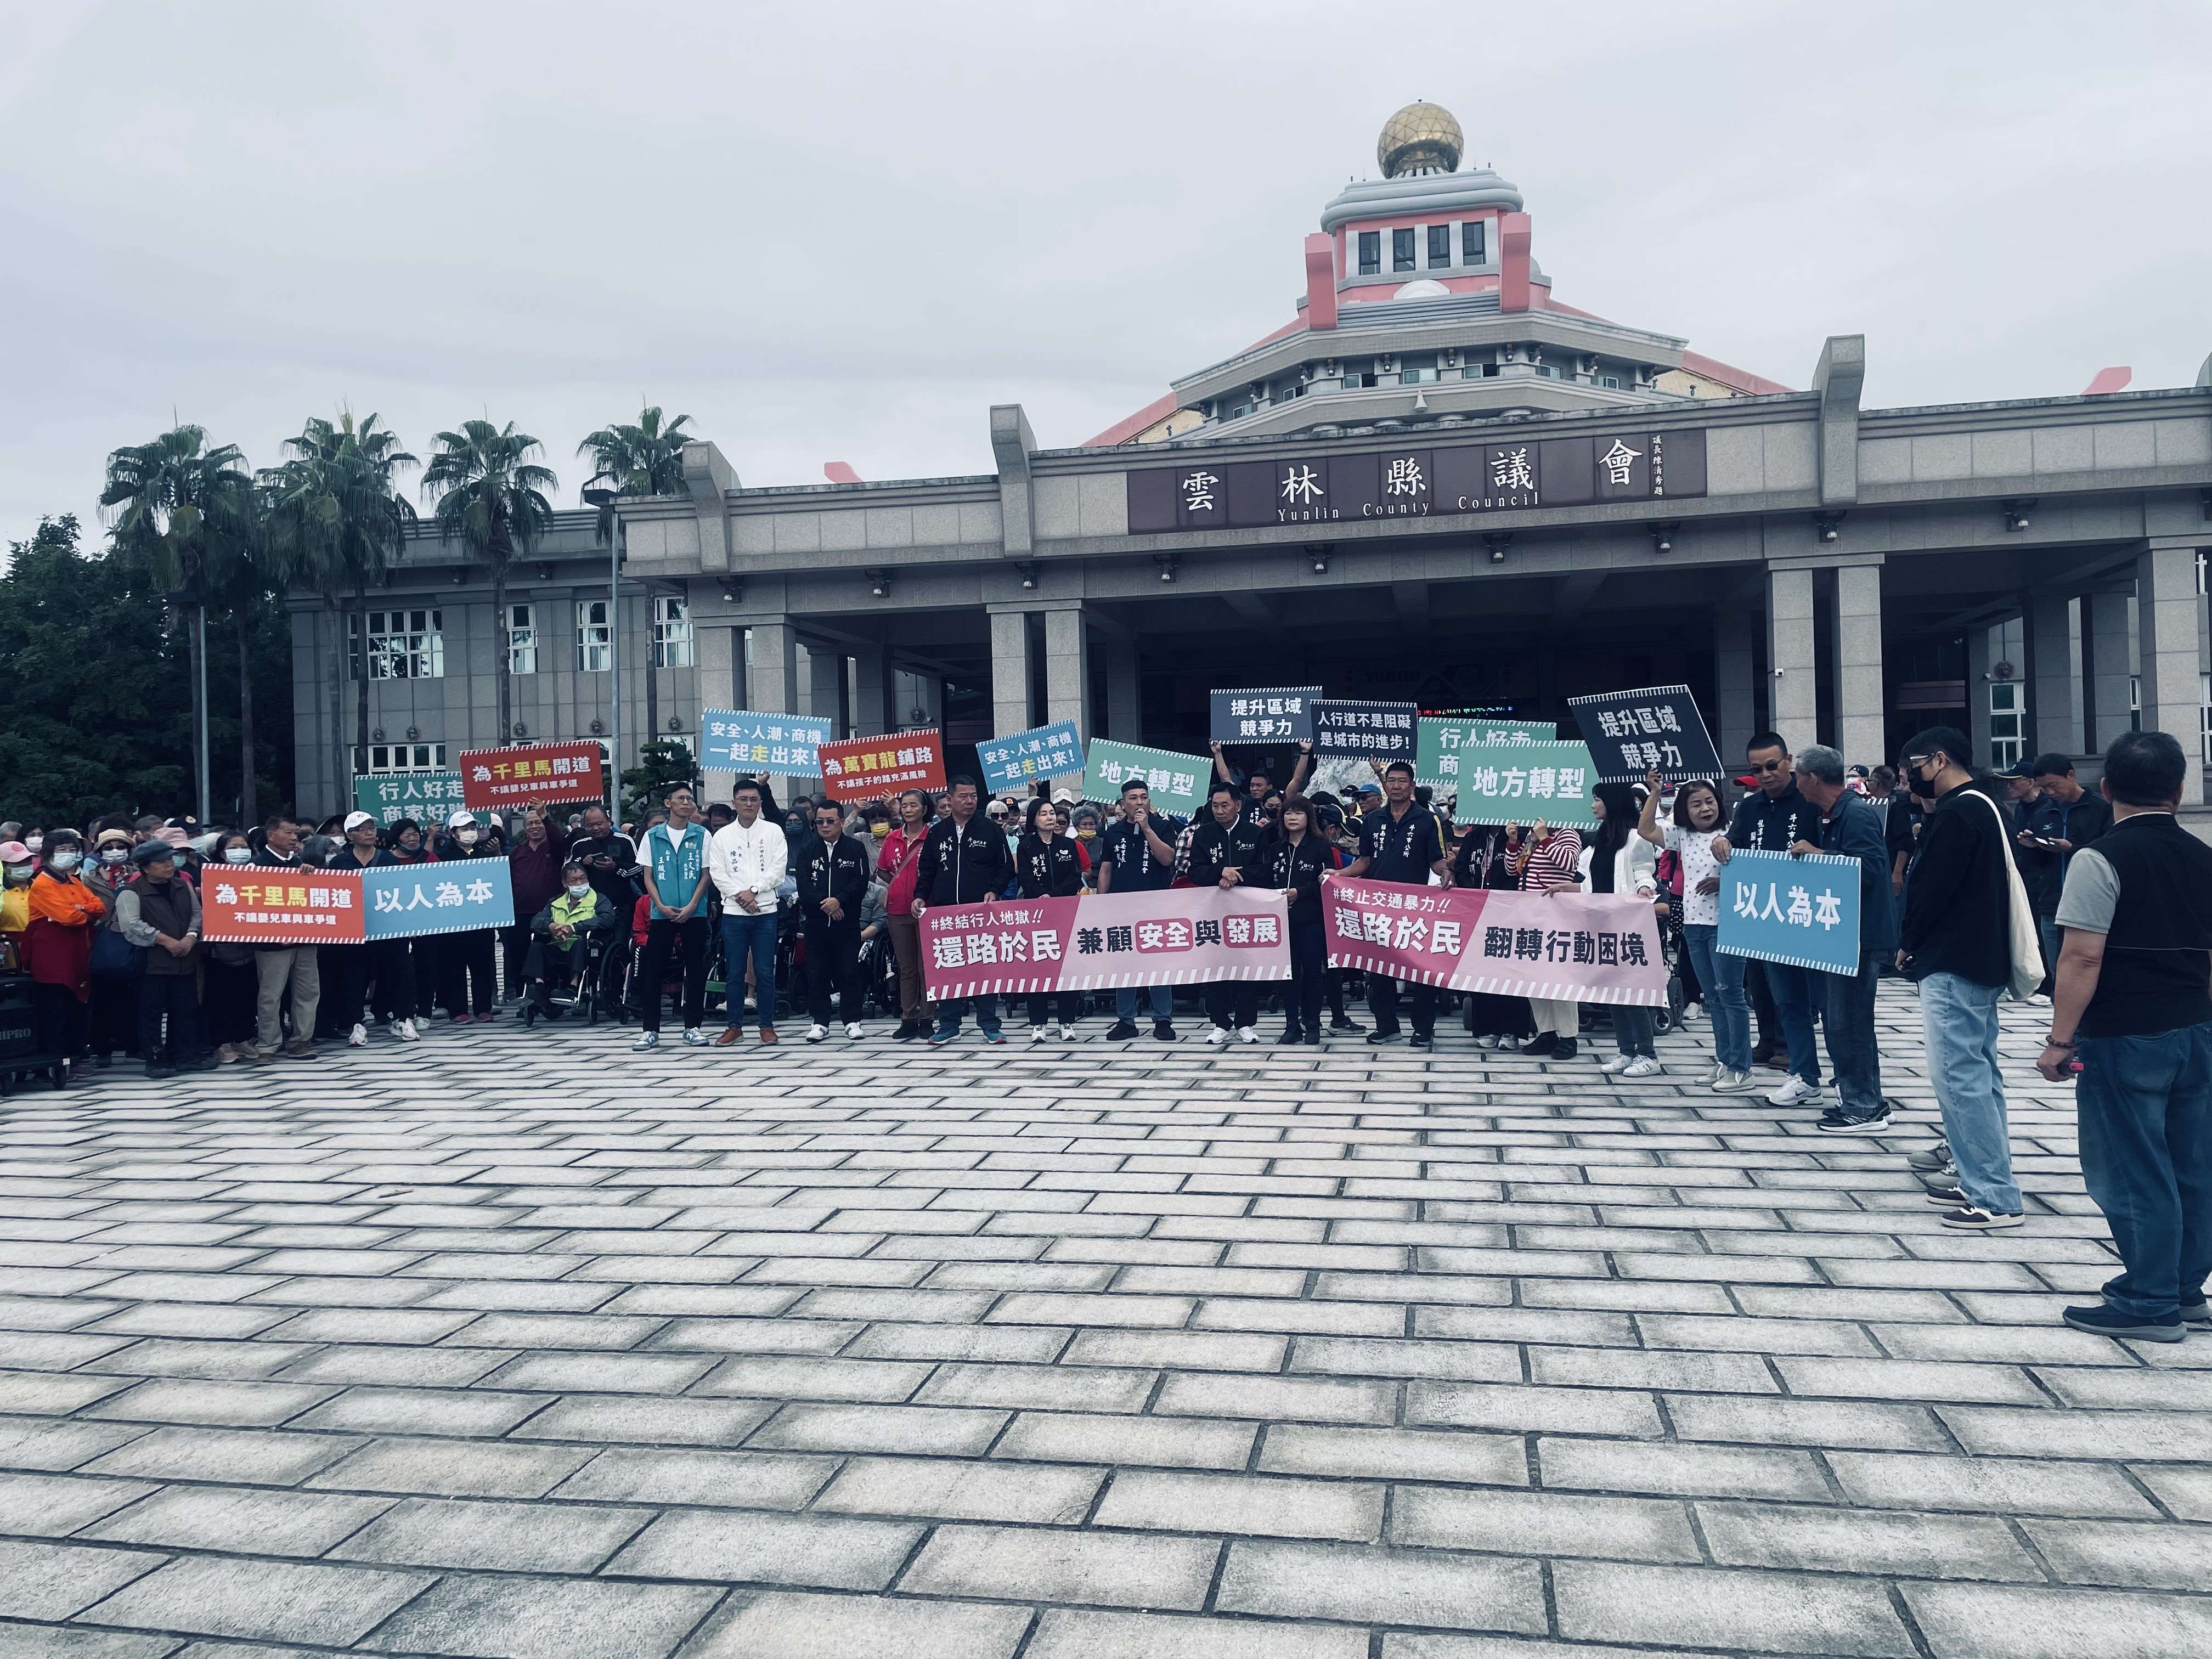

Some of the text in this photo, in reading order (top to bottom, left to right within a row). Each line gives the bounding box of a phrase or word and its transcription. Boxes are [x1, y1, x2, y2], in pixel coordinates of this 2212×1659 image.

[1183, 438, 1643, 511] 雲林縣議會
[1278, 491, 1539, 522] Yunlin County Council
[1231, 697, 1302, 716] 提升區域
[1318, 711, 1412, 730] 人行道不是阻礙
[1597, 704, 1682, 737] 提升區域
[710, 721, 822, 745] 安全、人潮、商機
[1239, 719, 1293, 737] 競爭力
[1319, 731, 1410, 750] 是城市的進步!
[709, 742, 819, 766] 一起走出來!
[824, 746, 933, 776] 為萬寶龍鋪路
[984, 731, 1073, 765] 安全、人潮、商機
[1620, 740, 1683, 770] 競爭力
[472, 756, 591, 783] 為千里馬開道
[837, 770, 927, 789] 不讓孩子的路充滿風險
[990, 749, 1075, 780] 一起走出來!
[1098, 759, 1195, 797] 地方轉型
[379, 780, 465, 802] 行人好走
[1472, 766, 1585, 799] 地方轉型
[215, 883, 353, 909] 為千里馬開道
[374, 878, 494, 913] 以人為本
[1333, 887, 1451, 913] #終止交通暴力!!
[1733, 881, 1842, 931] 以人為本
[234, 912, 337, 925] 不讓嬰兒車與車爭道
[930, 909, 1044, 931] #終結行人地獄!!
[1335, 906, 1462, 956] 還路於民
[932, 929, 1062, 970] 還路於民
[1077, 917, 1279, 955] 兼顧安全與發展
[1483, 926, 1649, 966] 翻轉行動困境
